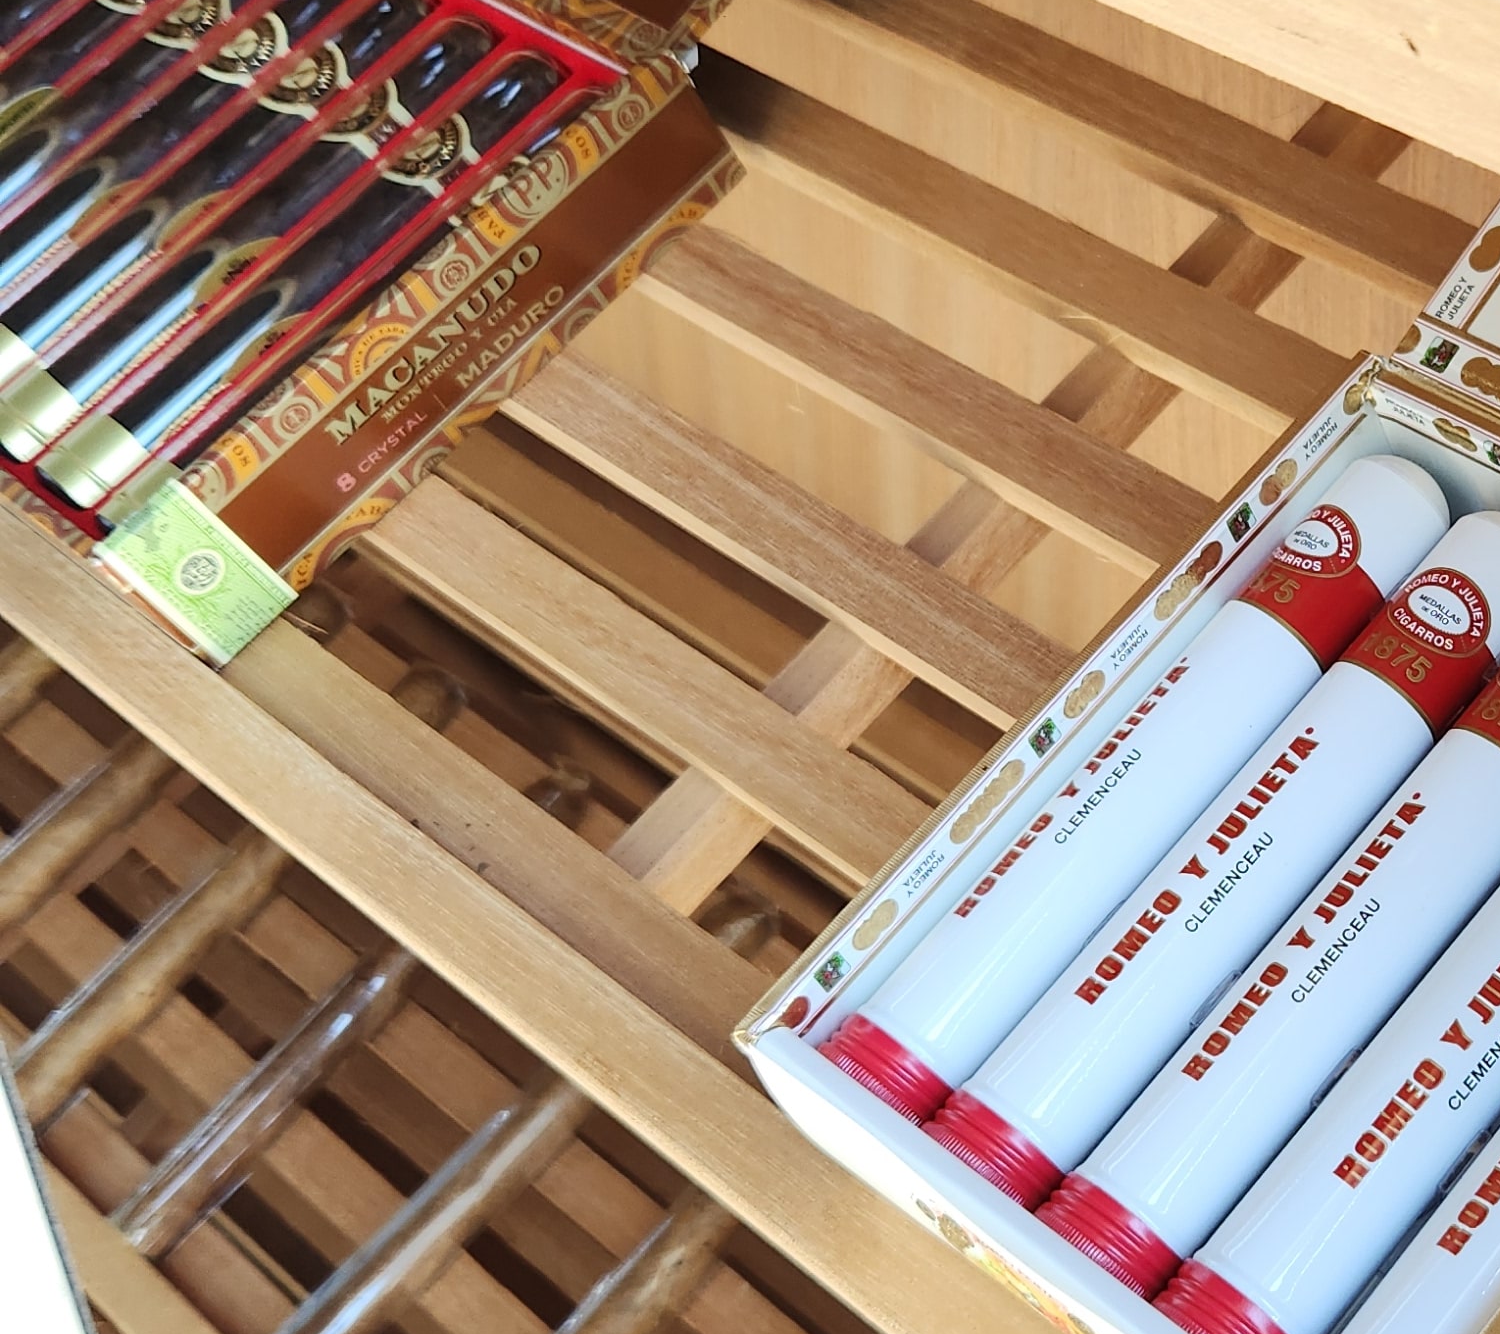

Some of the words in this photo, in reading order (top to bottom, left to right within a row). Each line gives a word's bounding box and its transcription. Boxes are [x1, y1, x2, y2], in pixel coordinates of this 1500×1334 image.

[454, 285, 565, 390] MADURO
[1435, 284, 1463, 318] ROMEO
[1447, 284, 1475, 321] JULIETA
[324, 243, 542, 446] MACANUDO
[336, 471, 358, 493] 8
[357, 411, 429, 474] CRYSTAL
[1327, 514, 1354, 560] JULIETA
[1109, 624, 1142, 660] JULIETA
[1393, 607, 1454, 651] CIGARROS
[1404, 572, 1450, 594] ROMEO
[1458, 586, 1485, 638] JULIETA
[1418, 592, 1462, 625] MEDALLAS
[1429, 609, 1450, 626] ORO
[1119, 629, 1149, 662] ROMEO
[1360, 631, 1433, 684] 1875
[1053, 748, 1143, 845] CLEMENCEAU
[953, 812, 1054, 919] ROMEO
[1057, 780, 1081, 798] Y
[1074, 888, 1183, 1005] ROMEO
[1178, 853, 1210, 879] Y
[1206, 735, 1321, 855] JULIETA
[1184, 831, 1274, 934] CLEMENCEAU
[1181, 961, 1289, 1082] ROMEO
[1286, 924, 1316, 950] Y
[1312, 800, 1427, 925] JULIETA
[1290, 898, 1381, 1004] CLEMENCEAU
[1332, 1057, 1446, 1190] ROMEO
[1439, 1017, 1474, 1052] Y
